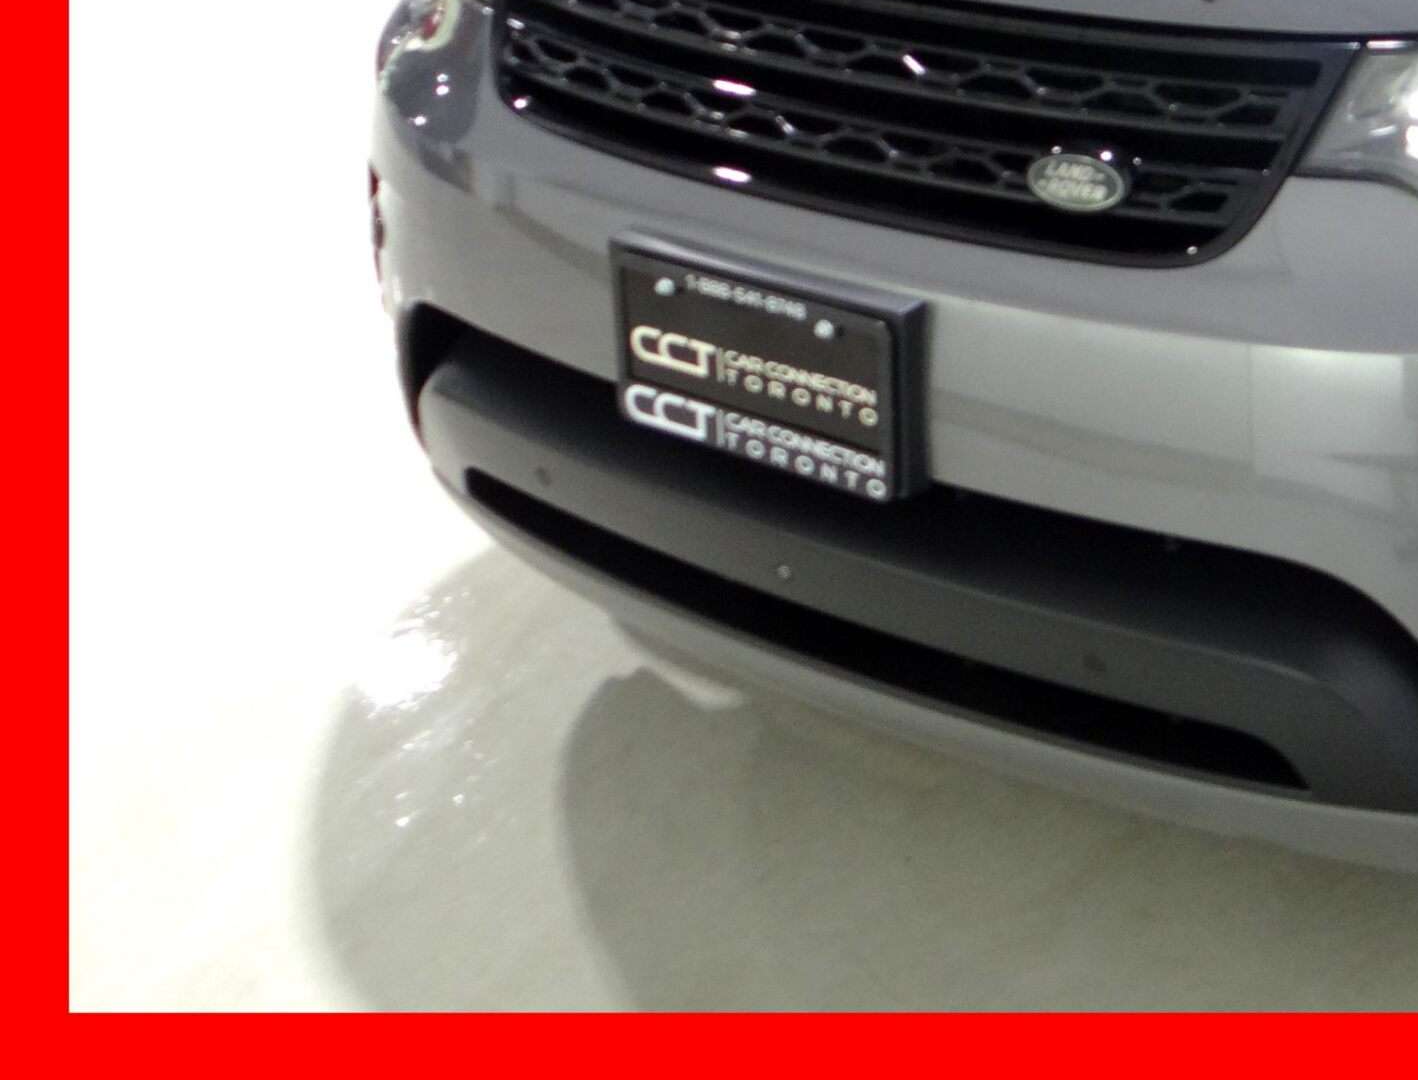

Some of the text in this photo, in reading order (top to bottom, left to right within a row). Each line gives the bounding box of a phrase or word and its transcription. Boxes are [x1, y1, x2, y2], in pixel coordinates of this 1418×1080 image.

[630, 325, 716, 378] CCT
[724, 350, 877, 406] CAR CONNECTION
[624, 383, 716, 442] CCT
[726, 368, 879, 426] TORONTO
[725, 412, 886, 476] CAR CONNECTION
[726, 432, 888, 500] TORONTO
